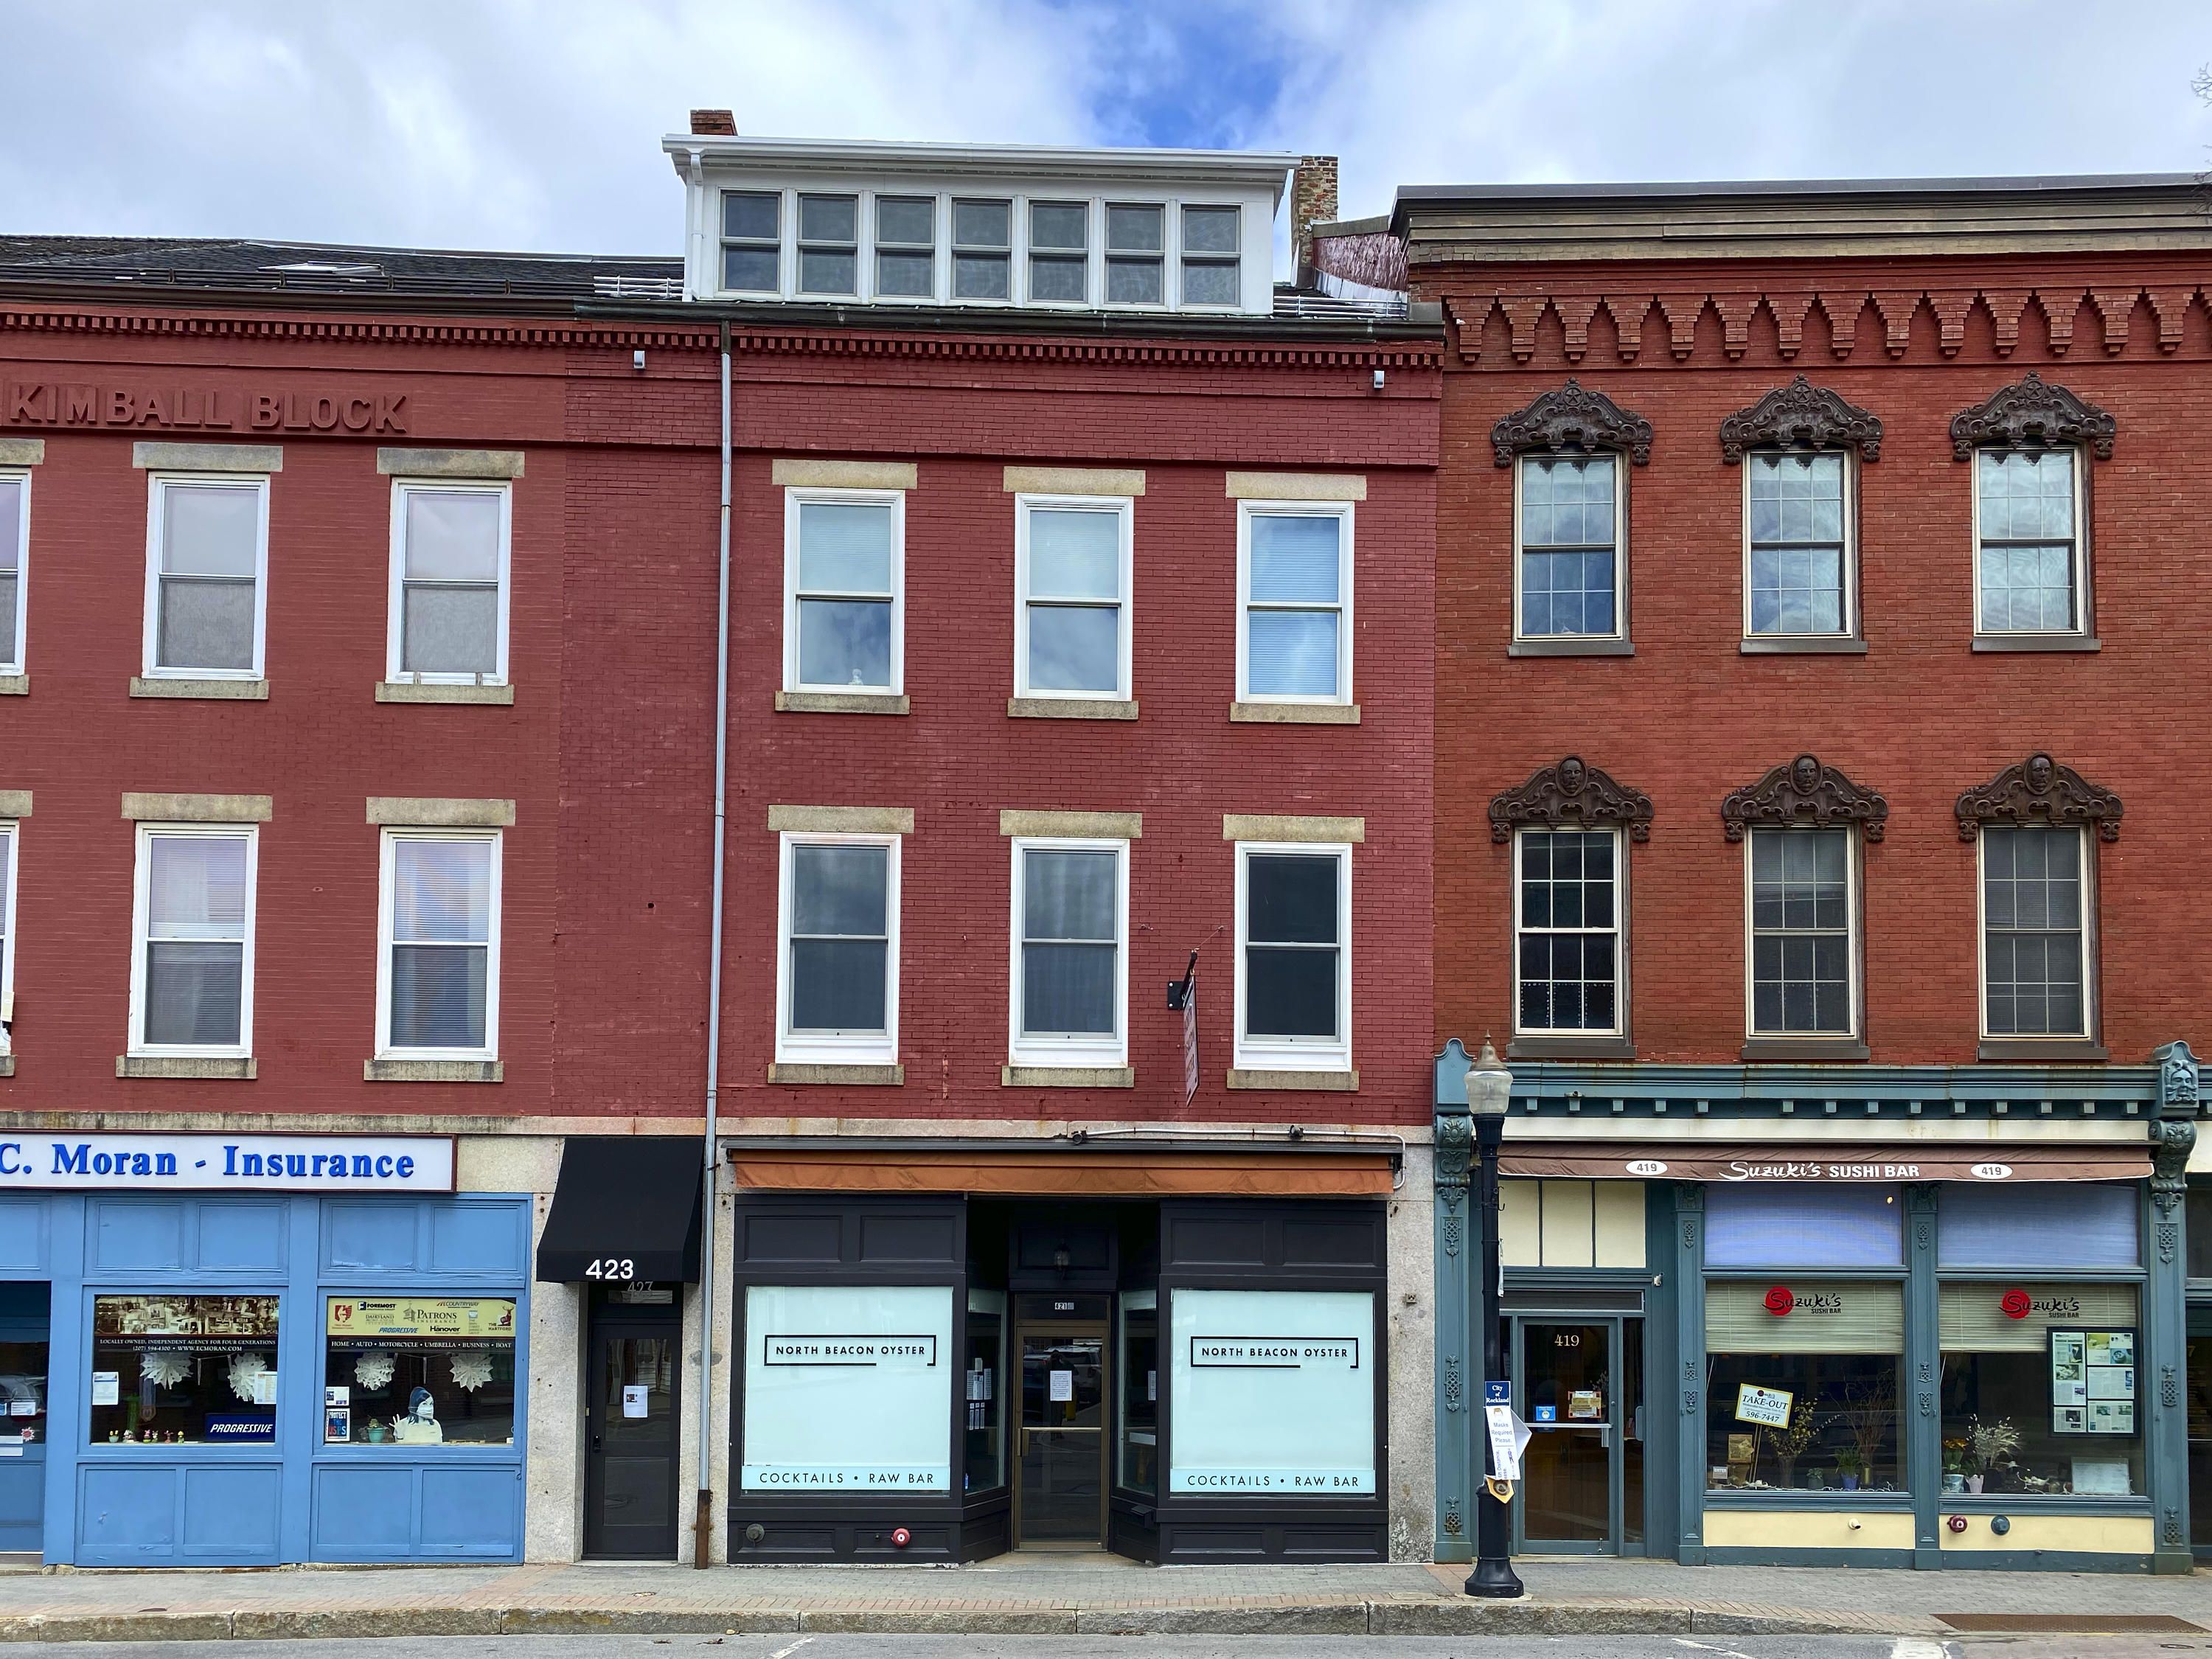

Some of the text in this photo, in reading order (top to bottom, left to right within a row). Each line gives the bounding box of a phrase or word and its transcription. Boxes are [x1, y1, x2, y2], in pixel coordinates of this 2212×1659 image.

[9, 384, 407, 434] KIMBALL BLOCK
[0, 1144, 32, 1174] C.
[51, 1144, 178, 1175] Moran
[223, 1145, 414, 1178] Insurance
[1637, 1163, 1658, 1172] 419
[1718, 1161, 1920, 1180] Suzuki's SUSHI BAR
[1981, 1166, 2002, 1175] 419
[585, 1259, 633, 1279] 423
[1761, 1293, 1841, 1310] Suzuki's
[1998, 1295, 2079, 1313] Suzuki's
[417, 1310, 457, 1319] PATRONS
[1554, 1334, 1579, 1346] 419
[776, 1346, 925, 1355] NORTH BEACON OYSTER
[1202, 1347, 1348, 1357] NORTH BEACON OYSTER
[1742, 1394, 1789, 1410] TAKE-OUT
[329, 1411, 347, 1419] PROTECT
[1746, 1411, 1779, 1422] 596-7447
[210, 1424, 274, 1433] PROGRESSIVE
[328, 1425, 347, 1435] USPS
[759, 1472, 933, 1484] COCKTAILS RAW BAR
[1188, 1475, 1359, 1486] COCKTAILS RAW BAR
